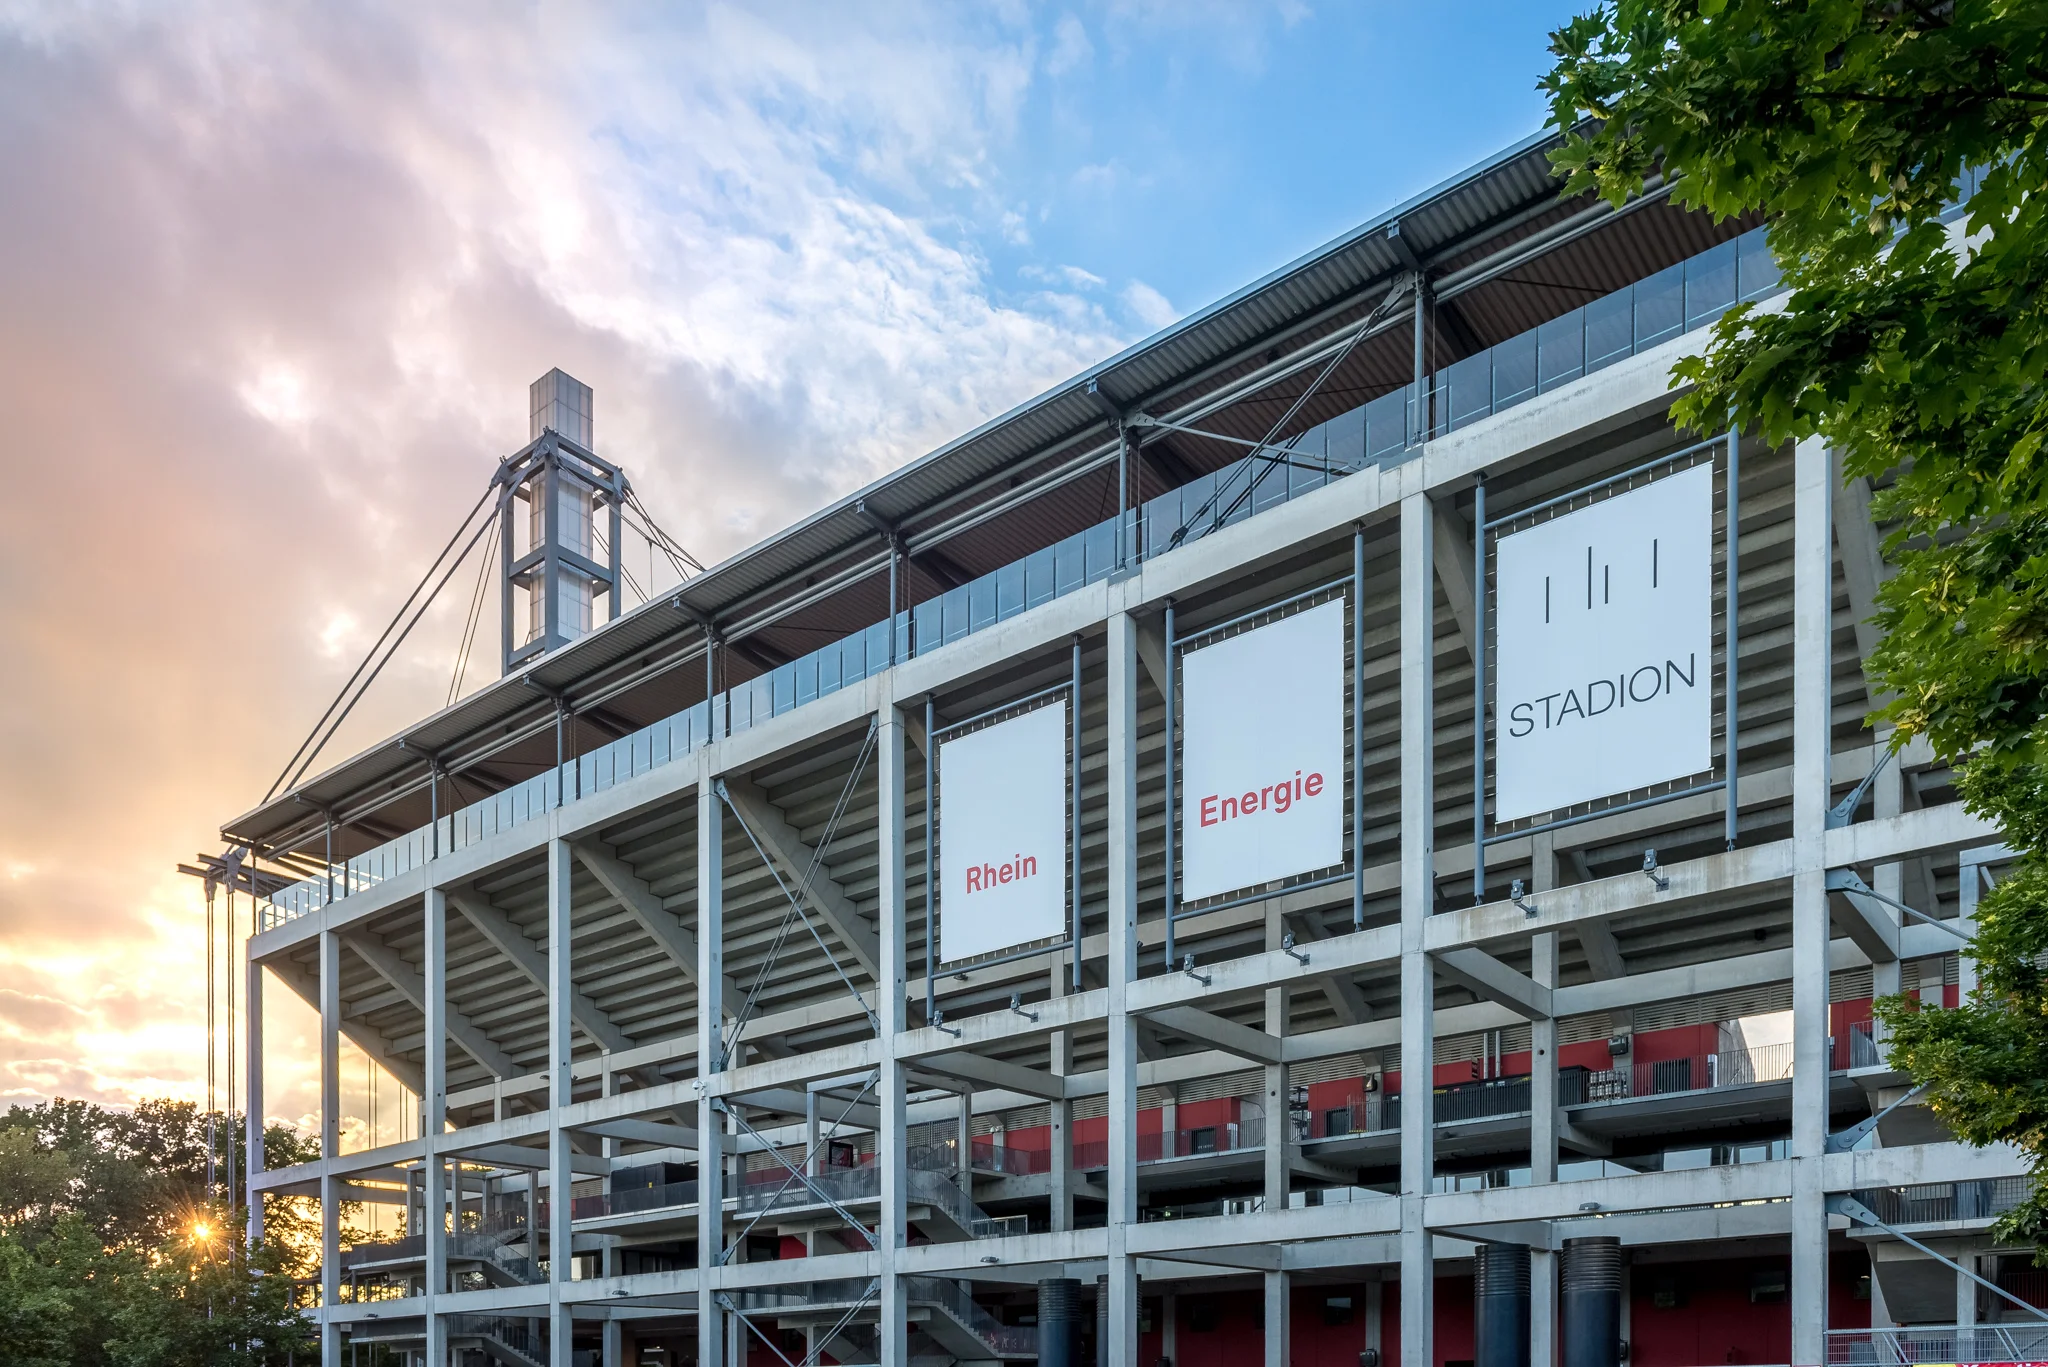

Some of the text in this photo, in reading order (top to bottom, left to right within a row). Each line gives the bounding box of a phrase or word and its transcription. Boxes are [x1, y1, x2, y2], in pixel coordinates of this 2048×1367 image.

[1509, 652, 1695, 738] STADION
[1200, 770, 1323, 827] Energie
[966, 853, 1037, 894] Rhein
